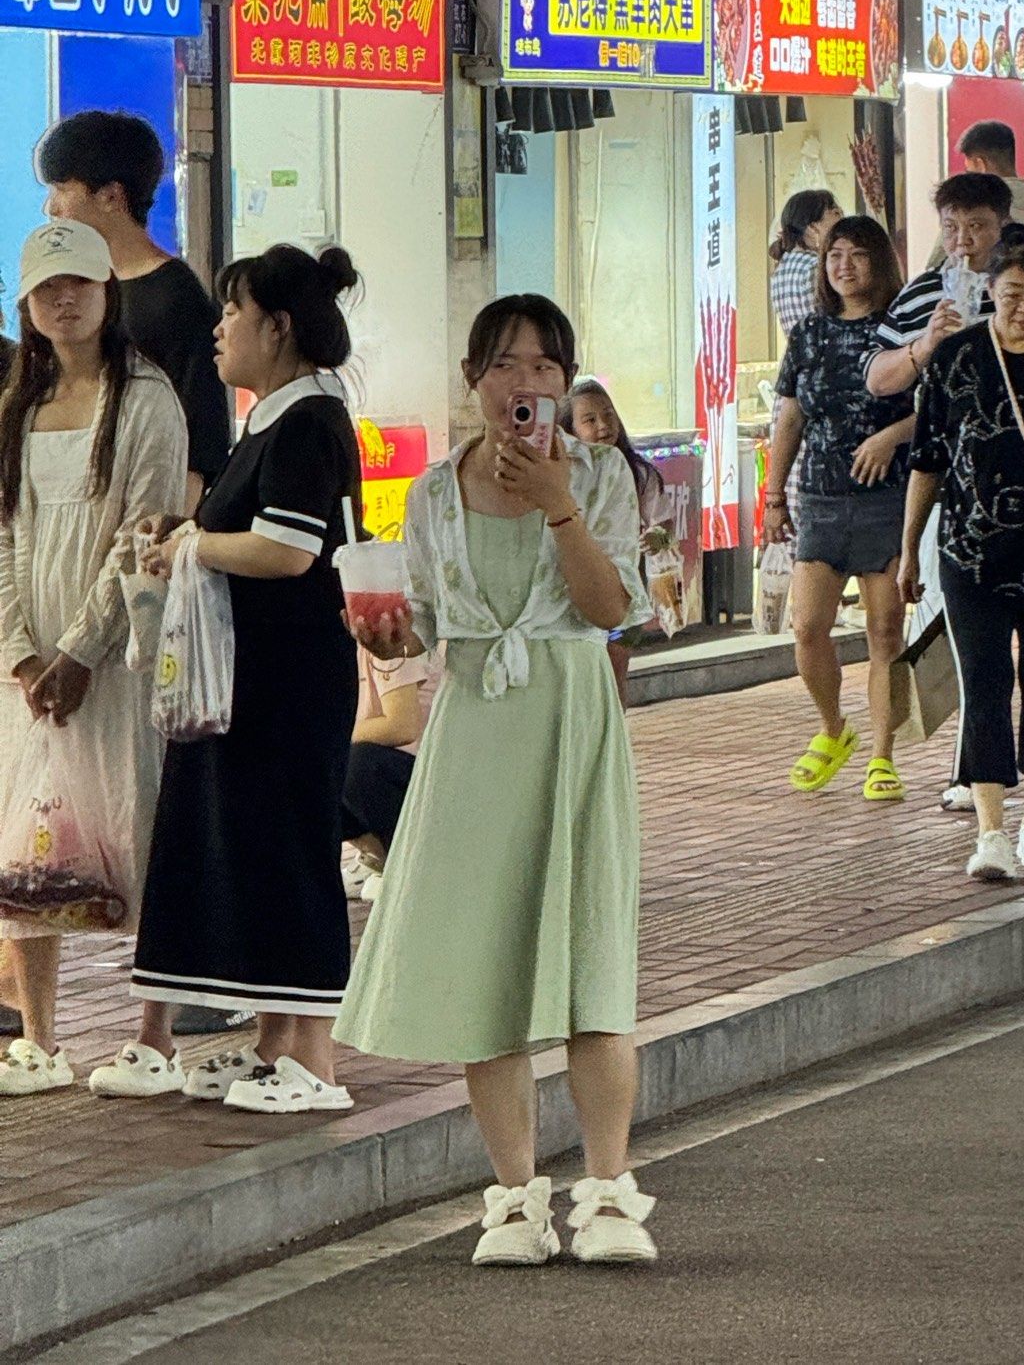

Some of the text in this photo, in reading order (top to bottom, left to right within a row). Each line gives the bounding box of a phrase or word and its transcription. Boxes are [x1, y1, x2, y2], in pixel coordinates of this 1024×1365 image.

[251, 36, 427, 73] 北戴河非物质文化遗产
[708, 106, 721, 270] 串王道
